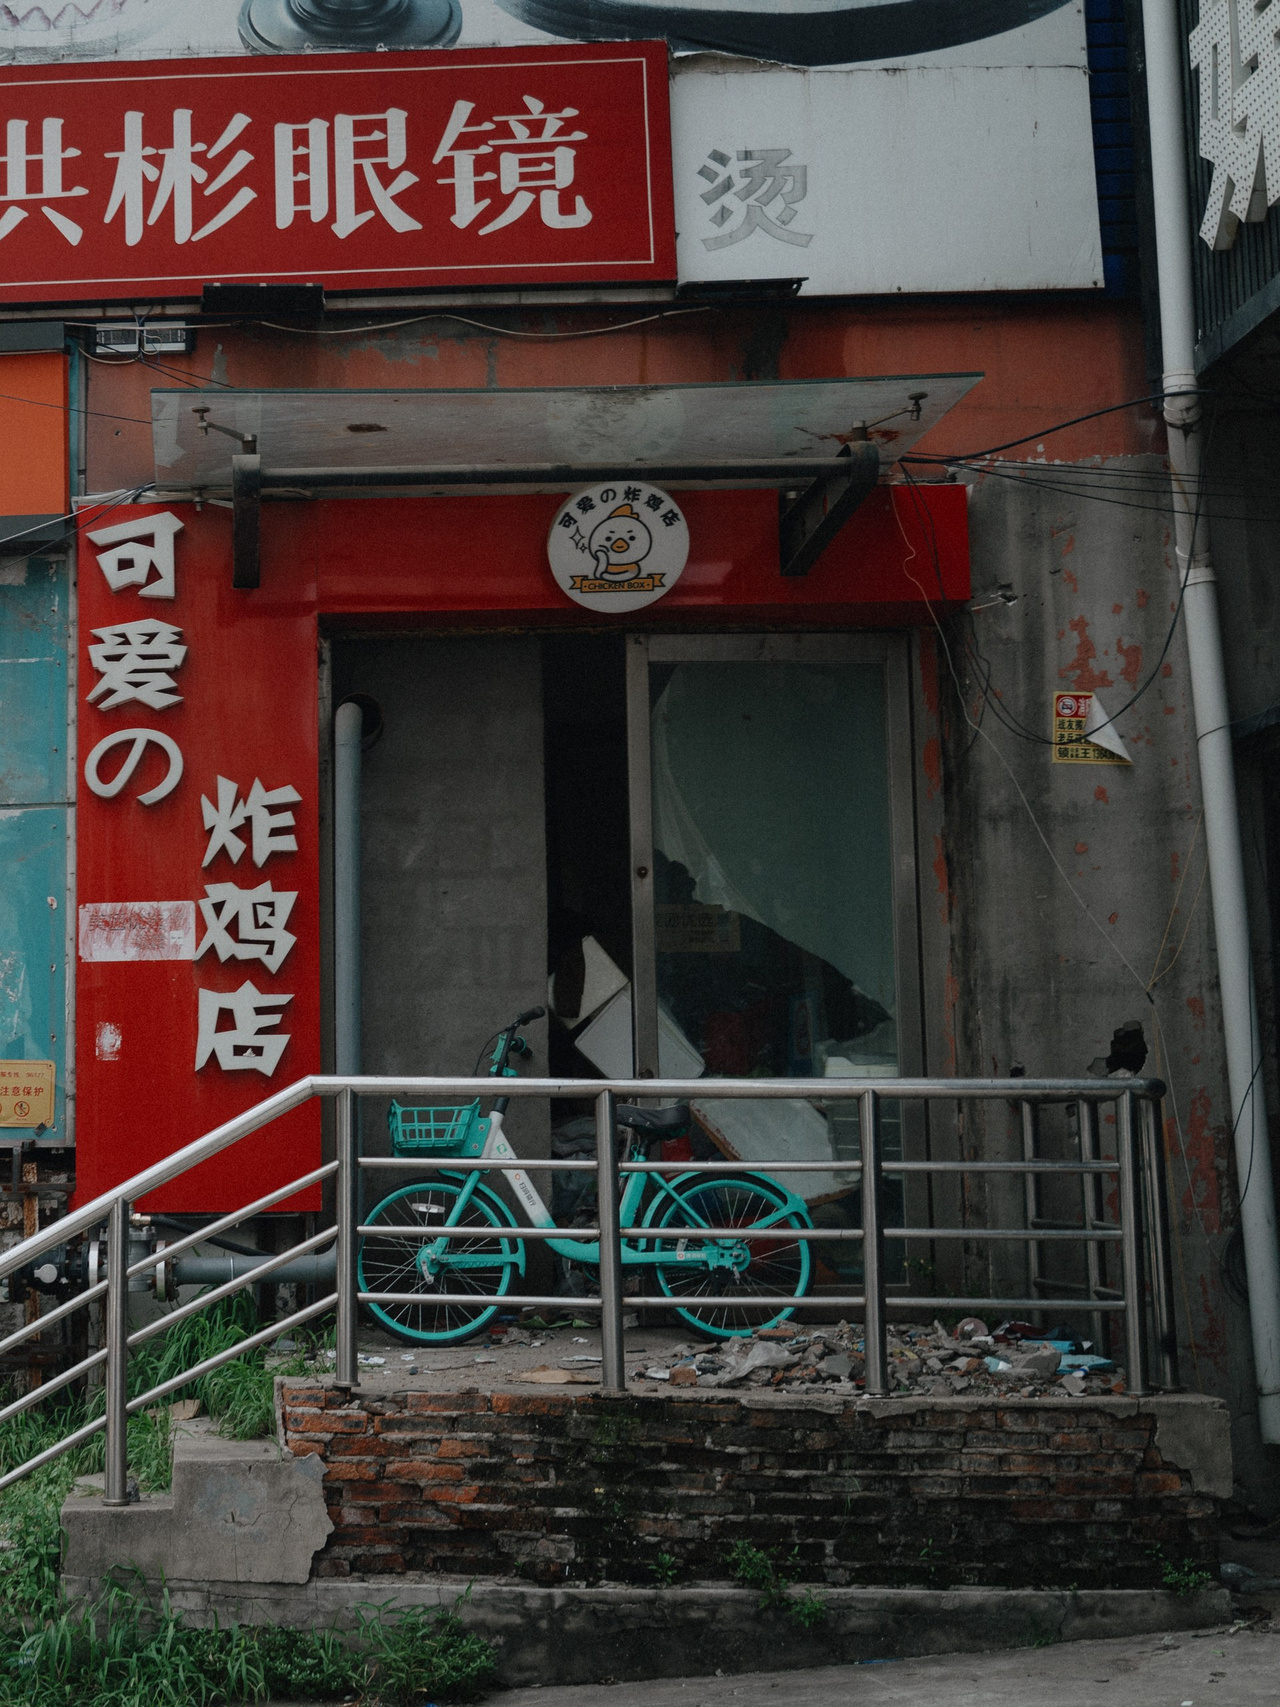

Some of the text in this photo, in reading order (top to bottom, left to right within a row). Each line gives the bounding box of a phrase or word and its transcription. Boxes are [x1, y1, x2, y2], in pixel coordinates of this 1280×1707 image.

[696, 148, 815, 253] 烫
[587, 581, 646, 591] CHICKEN BOX
[85, 511, 188, 806] 可爱の
[194, 774, 304, 1078] 炸鸡店
[0, 1085, 44, 1097] 注意保护
